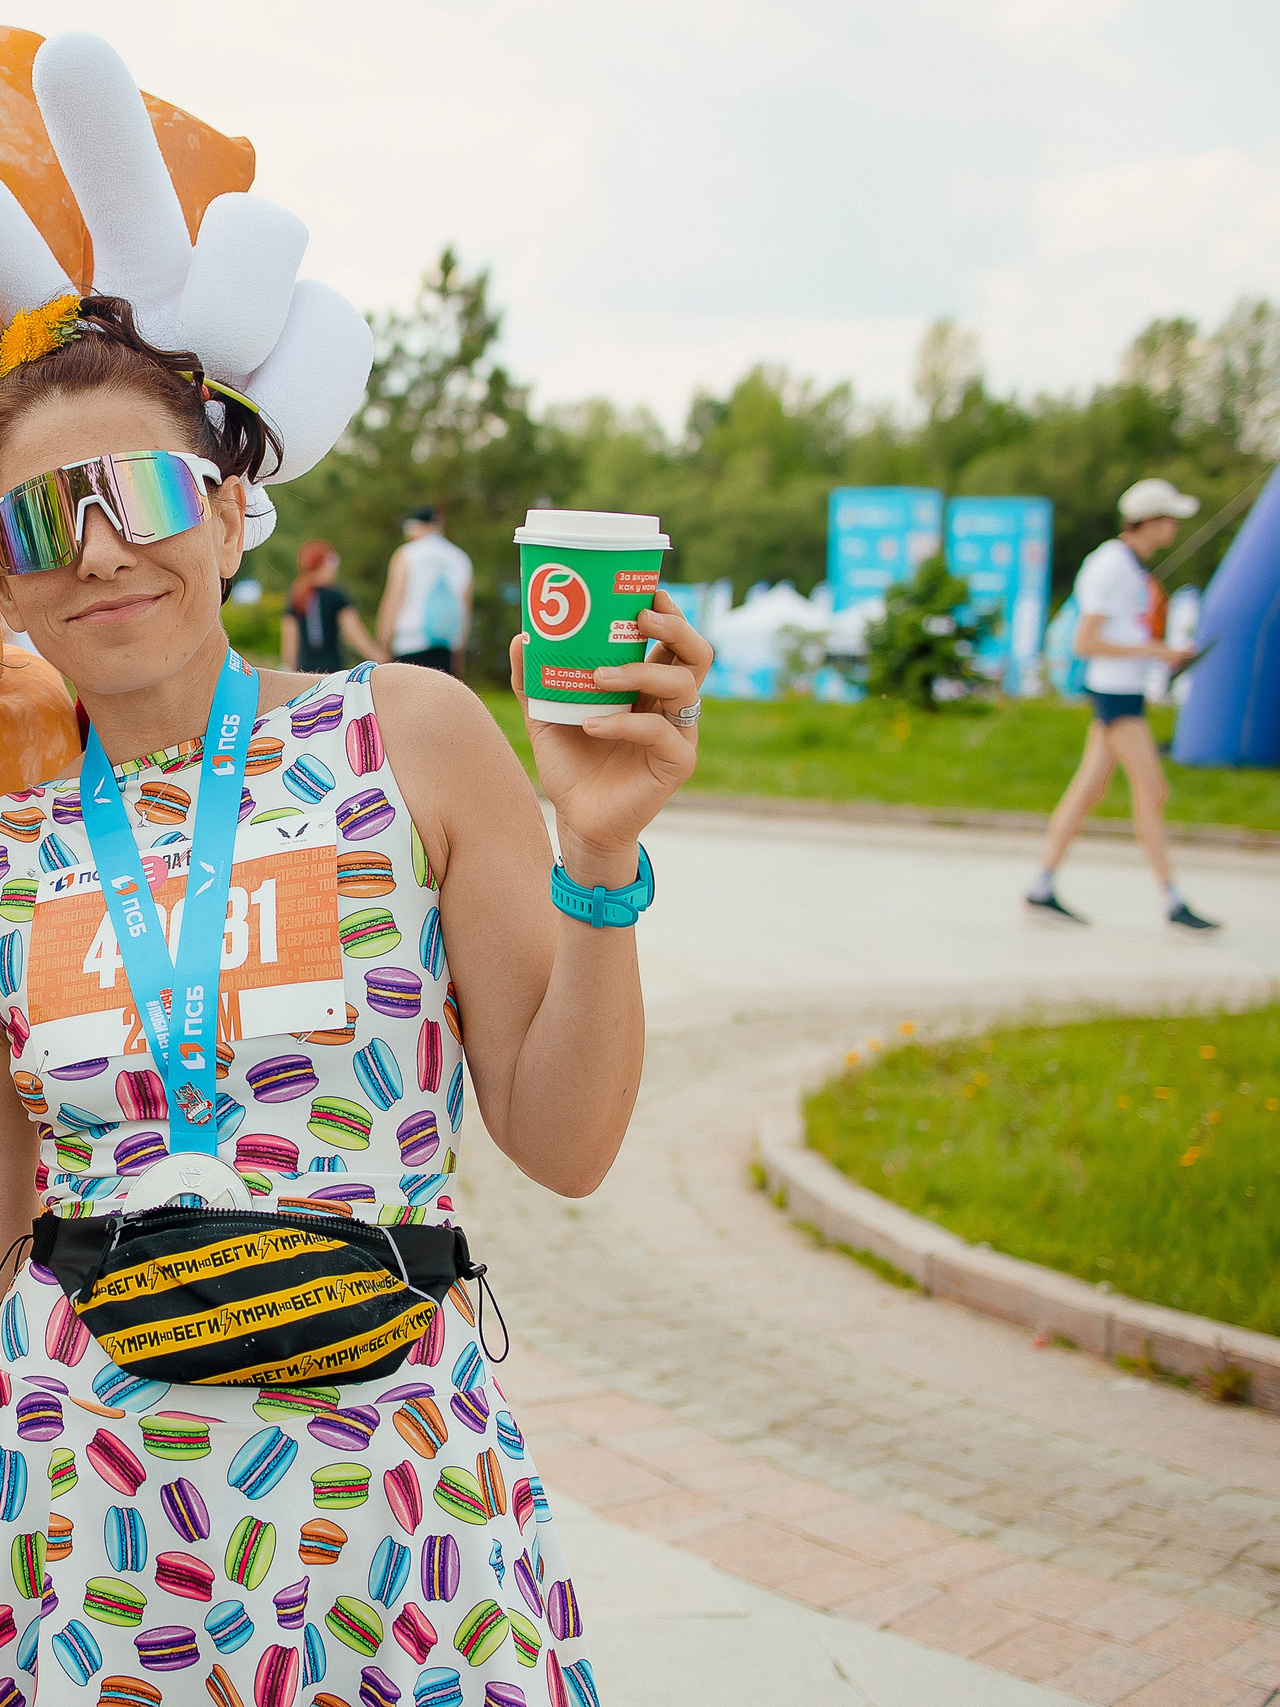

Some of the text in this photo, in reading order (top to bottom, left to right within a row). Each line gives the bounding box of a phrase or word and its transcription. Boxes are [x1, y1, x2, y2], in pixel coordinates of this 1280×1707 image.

[620, 573, 631, 581] За
[636, 584, 641, 593] у
[538, 569, 573, 626] 5
[614, 622, 625, 630] За
[545, 667, 556, 676] За
[218, 714, 241, 750] ПСБ
[79, 869, 101, 884] ПС
[121, 897, 147, 938] ПСБ
[286, 928, 332, 947] СЕРДЦЕМ
[145, 1000, 169, 1033] #ЛЮБИ
[184, 985, 204, 1035] ПСБ
[107, 1272, 148, 1297] БЕГИ
[210, 1243, 258, 1268] БЕГИ
[268, 1232, 314, 1252] УМРИ
[116, 1330, 161, 1355] УМРИ
[172, 1319, 220, 1342] БЕГИ
[230, 1305, 280, 1327] УМРИ
[291, 1283, 337, 1311] БЕГИ
[251, 1365, 300, 1384] БЕГИ
[313, 1345, 360, 1370] УМРИ
[369, 1325, 402, 1353] БЕГИ
